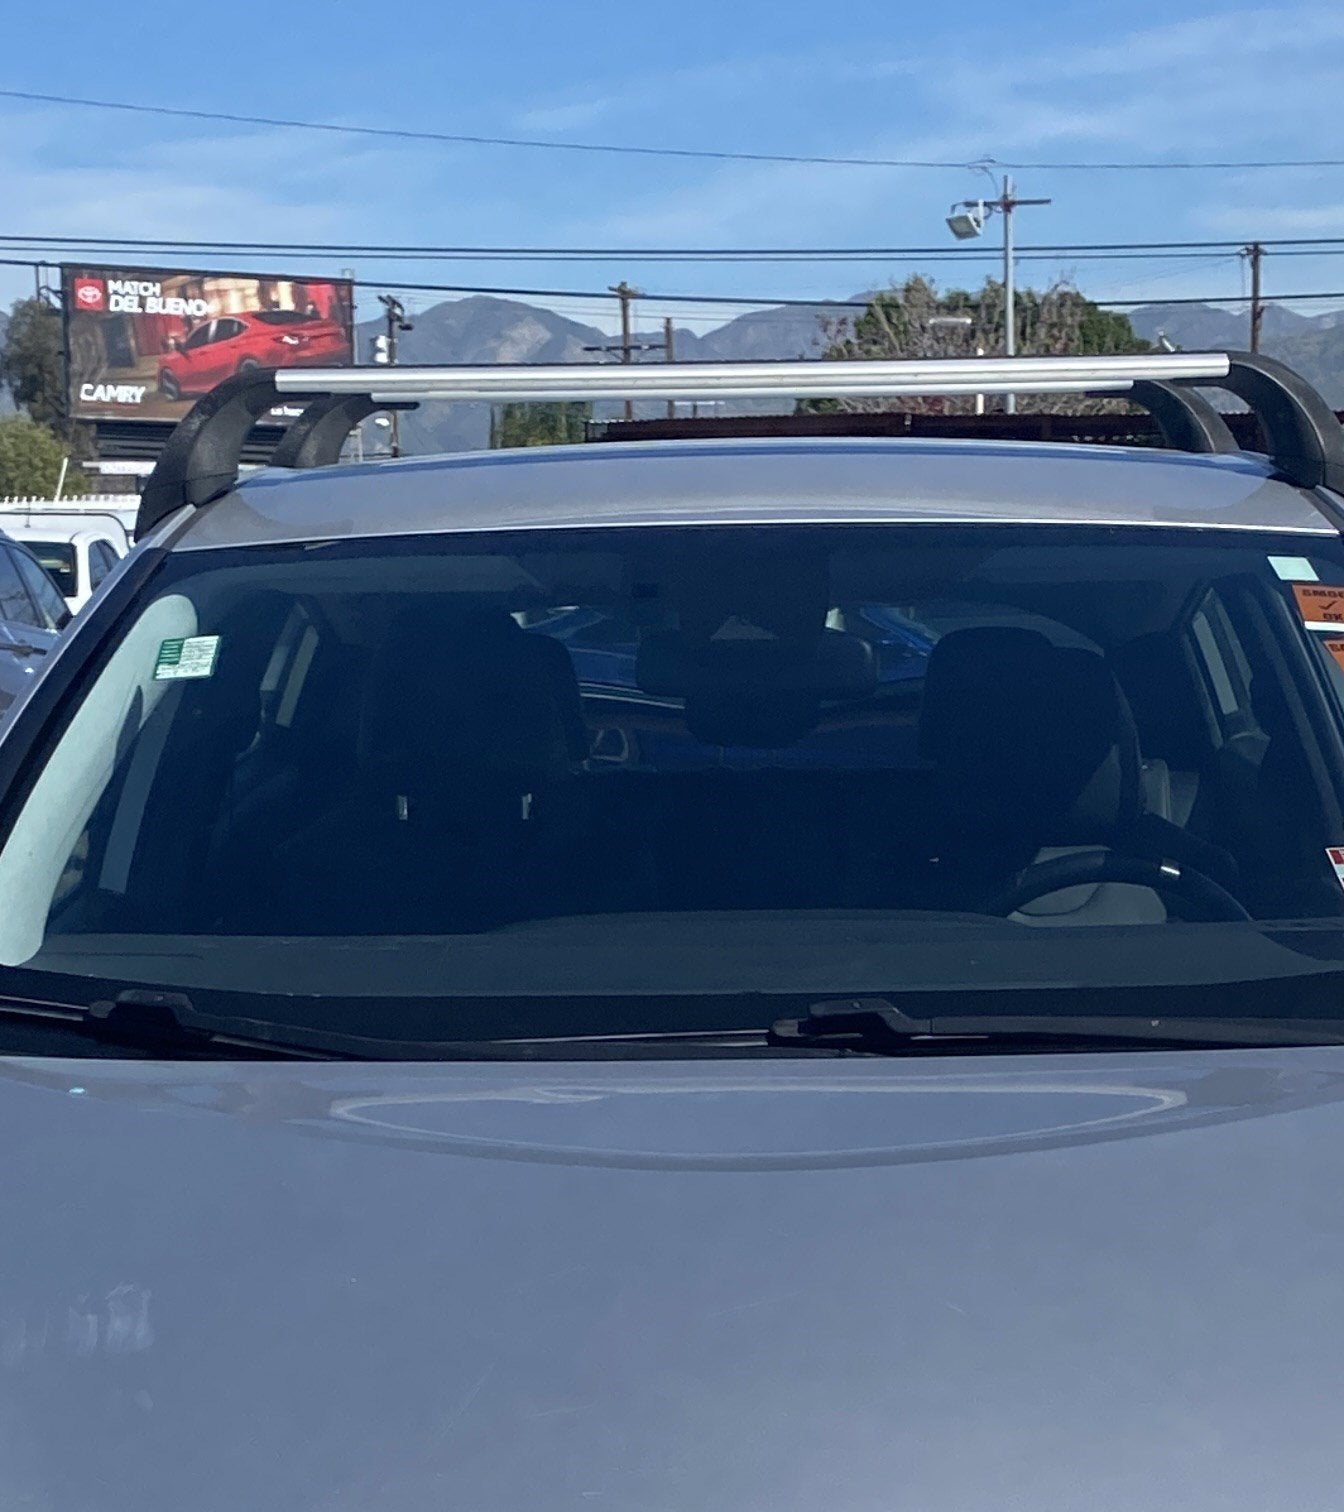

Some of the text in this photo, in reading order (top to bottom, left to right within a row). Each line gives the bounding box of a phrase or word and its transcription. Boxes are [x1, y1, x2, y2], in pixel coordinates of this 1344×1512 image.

[107, 279, 161, 297] MATCH
[109, 294, 207, 317] DEL BUENO
[80, 383, 146, 404] CAMRY
